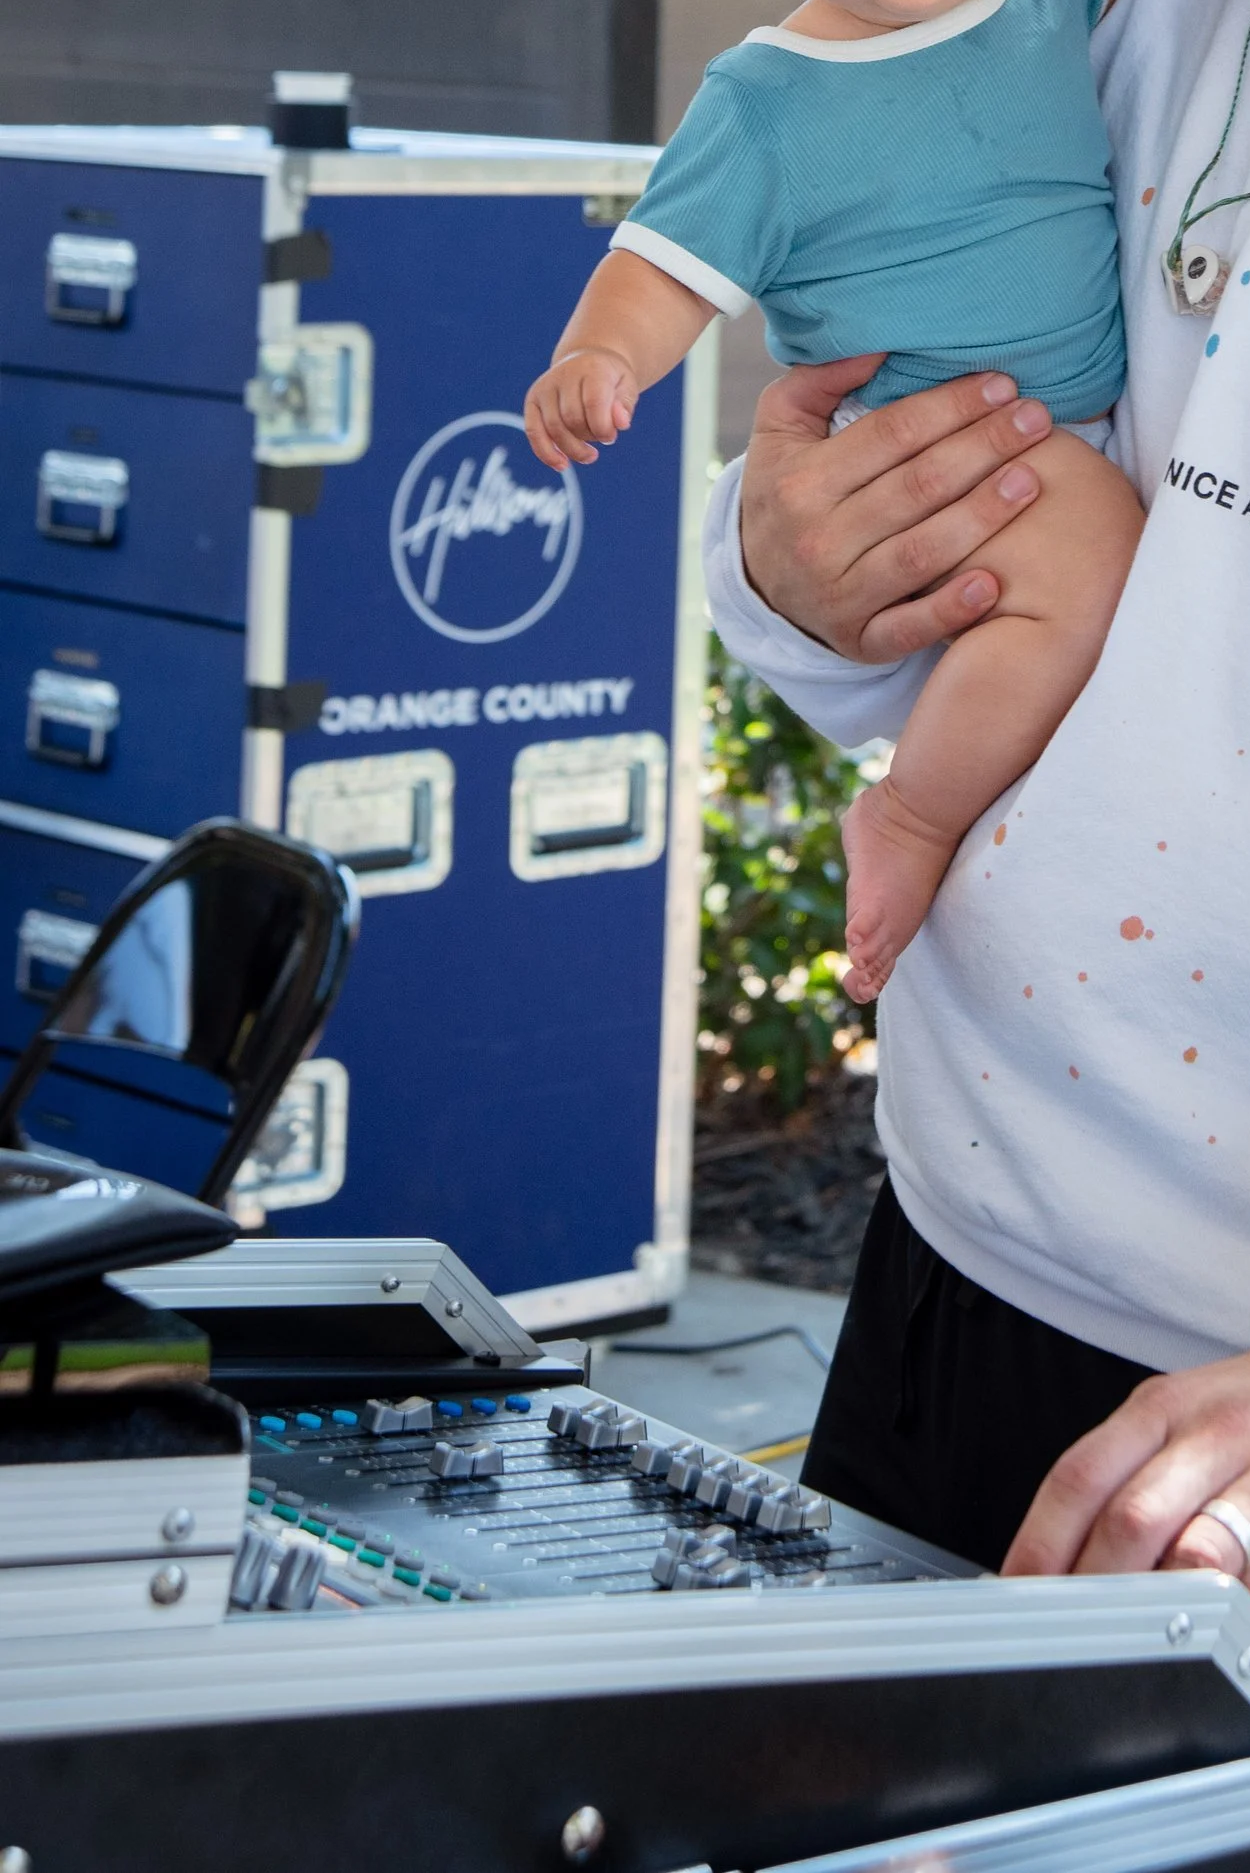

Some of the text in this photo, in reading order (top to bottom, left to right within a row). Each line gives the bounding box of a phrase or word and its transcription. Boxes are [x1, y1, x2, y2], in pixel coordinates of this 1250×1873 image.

[1163, 457, 1239, 510] NICE
[318, 677, 635, 736] ORANGE COUNTY
